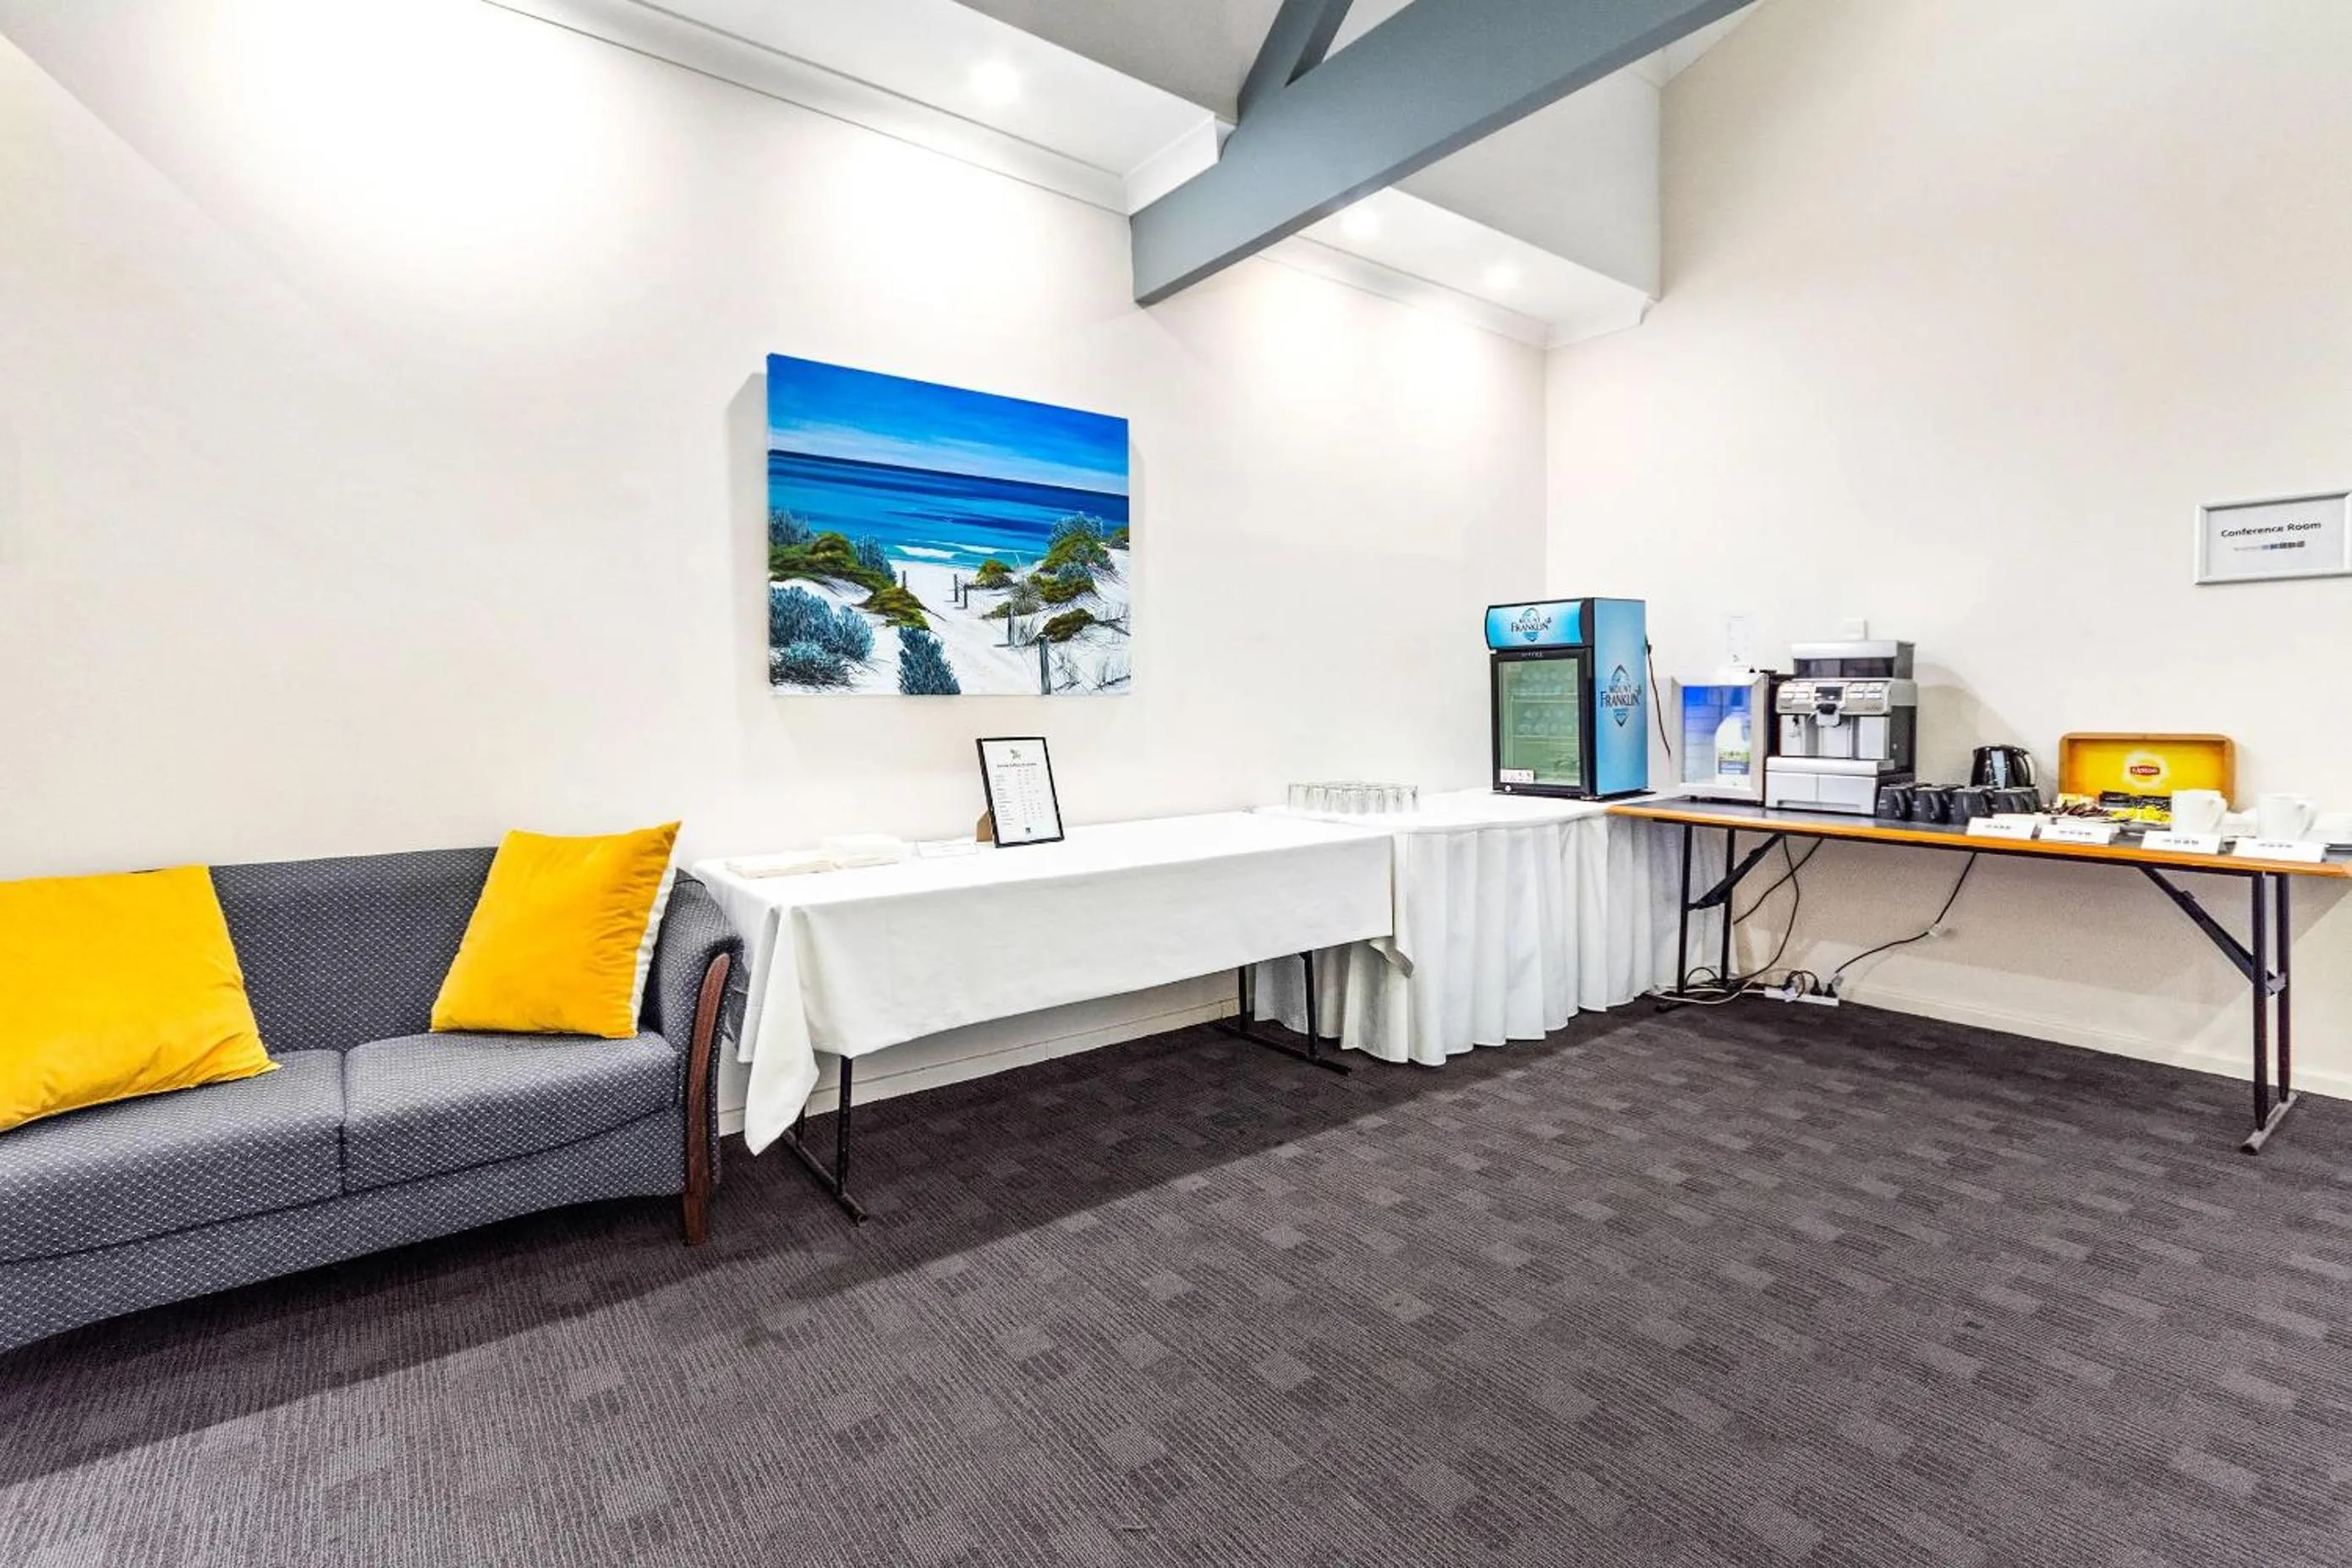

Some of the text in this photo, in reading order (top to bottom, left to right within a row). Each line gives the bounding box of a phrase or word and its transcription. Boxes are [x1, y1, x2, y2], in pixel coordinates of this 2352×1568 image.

[2221, 521, 2322, 538] Conference Room
[1510, 622, 1549, 633] FRANKLIN
[1600, 690, 1641, 707] FRANKLIN
